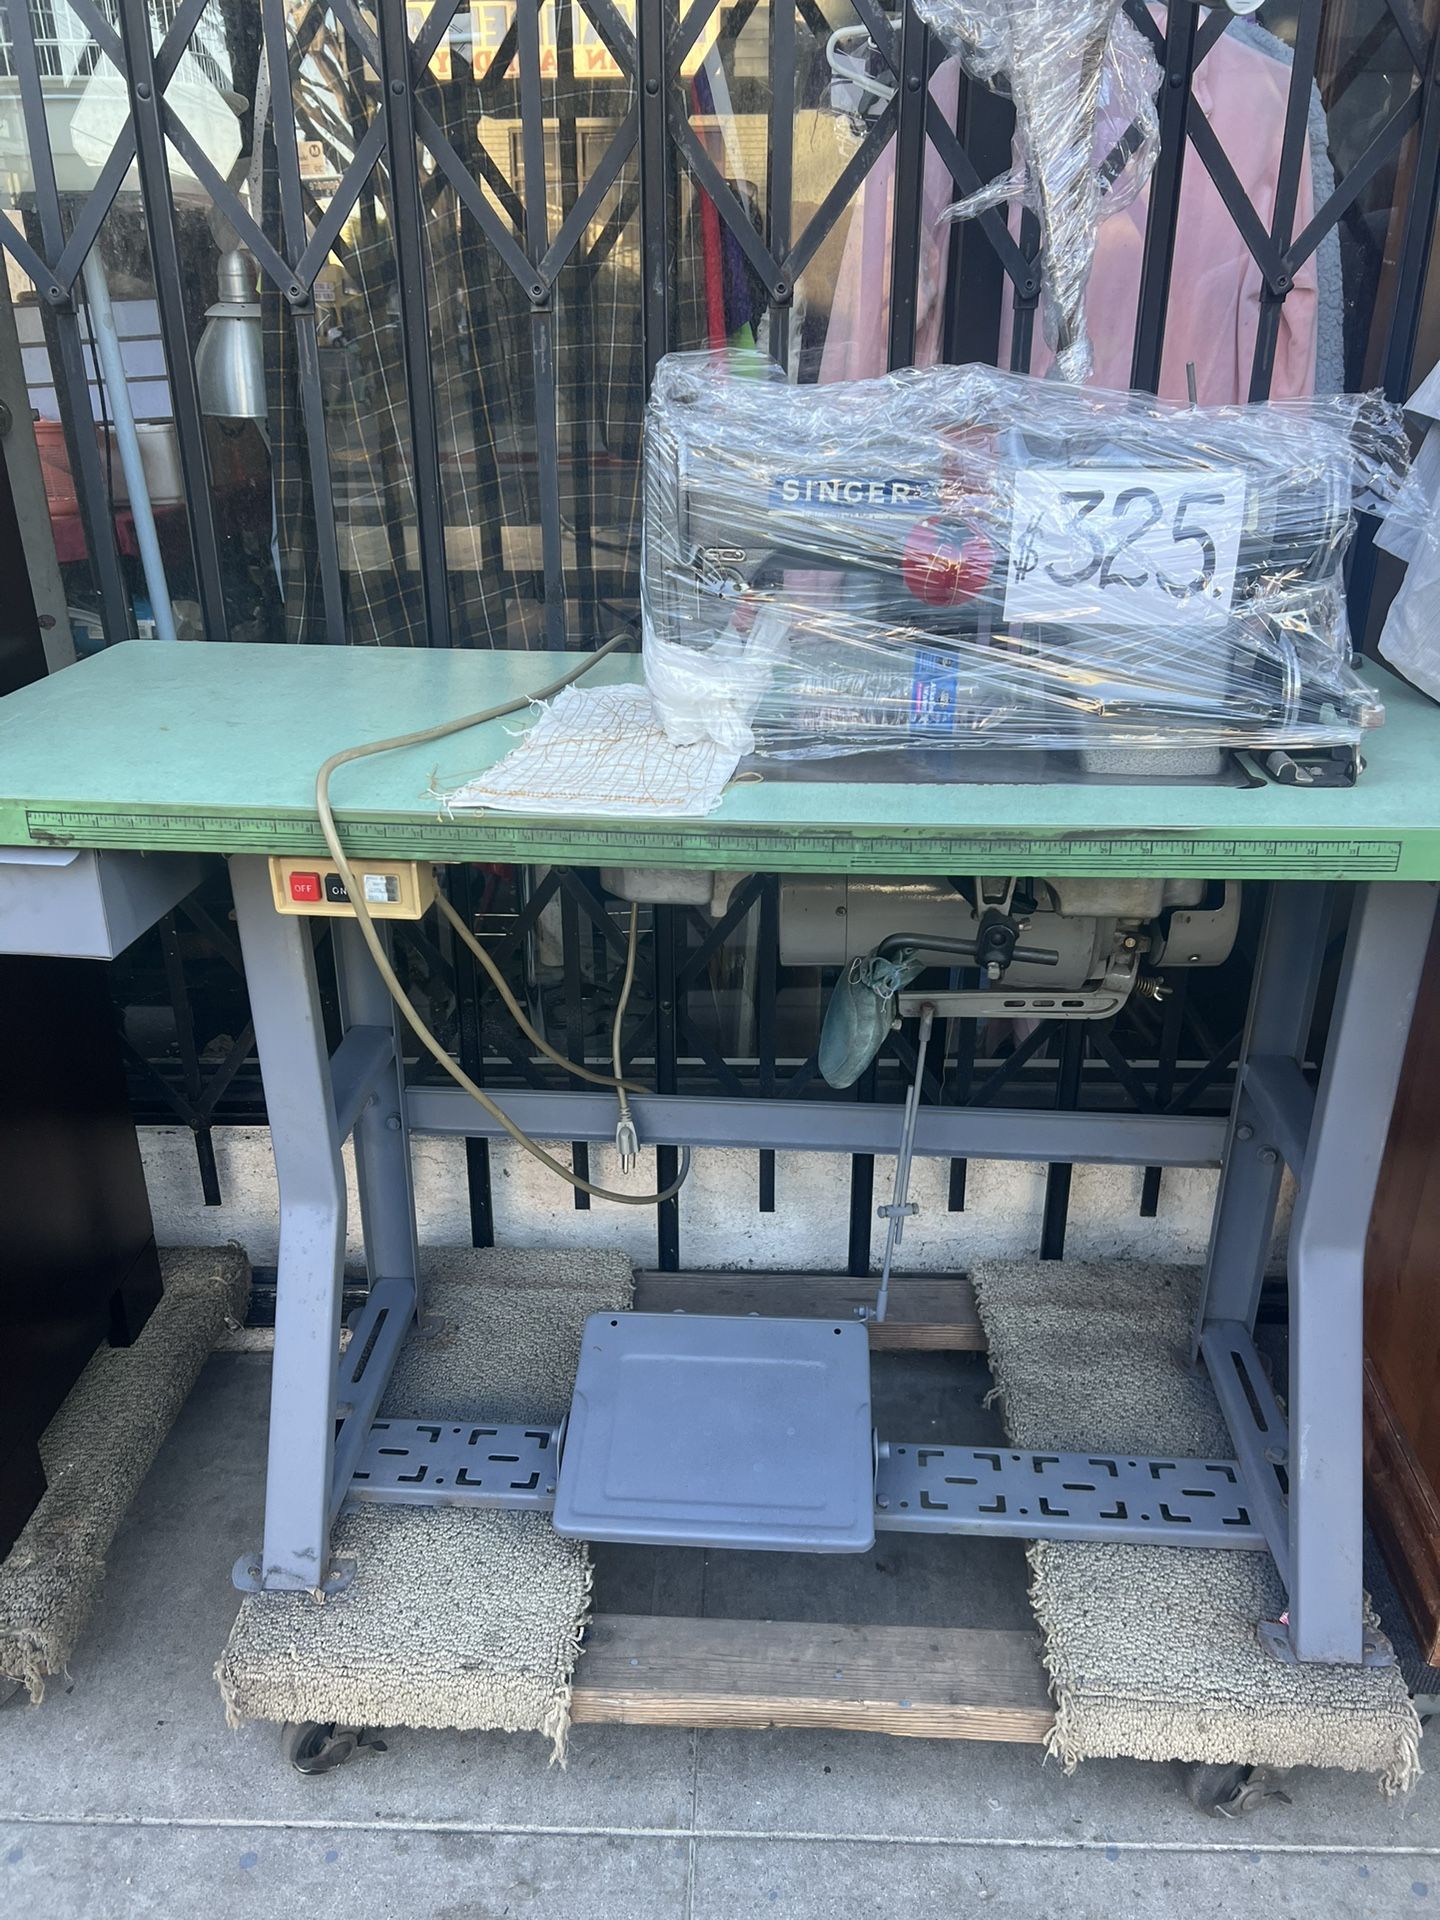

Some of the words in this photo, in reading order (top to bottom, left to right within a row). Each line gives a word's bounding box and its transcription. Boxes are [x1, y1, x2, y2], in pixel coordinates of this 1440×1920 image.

[782, 479, 910, 504] SINGER
[294, 884, 312, 893] OFF
[331, 886, 348, 895] ON
